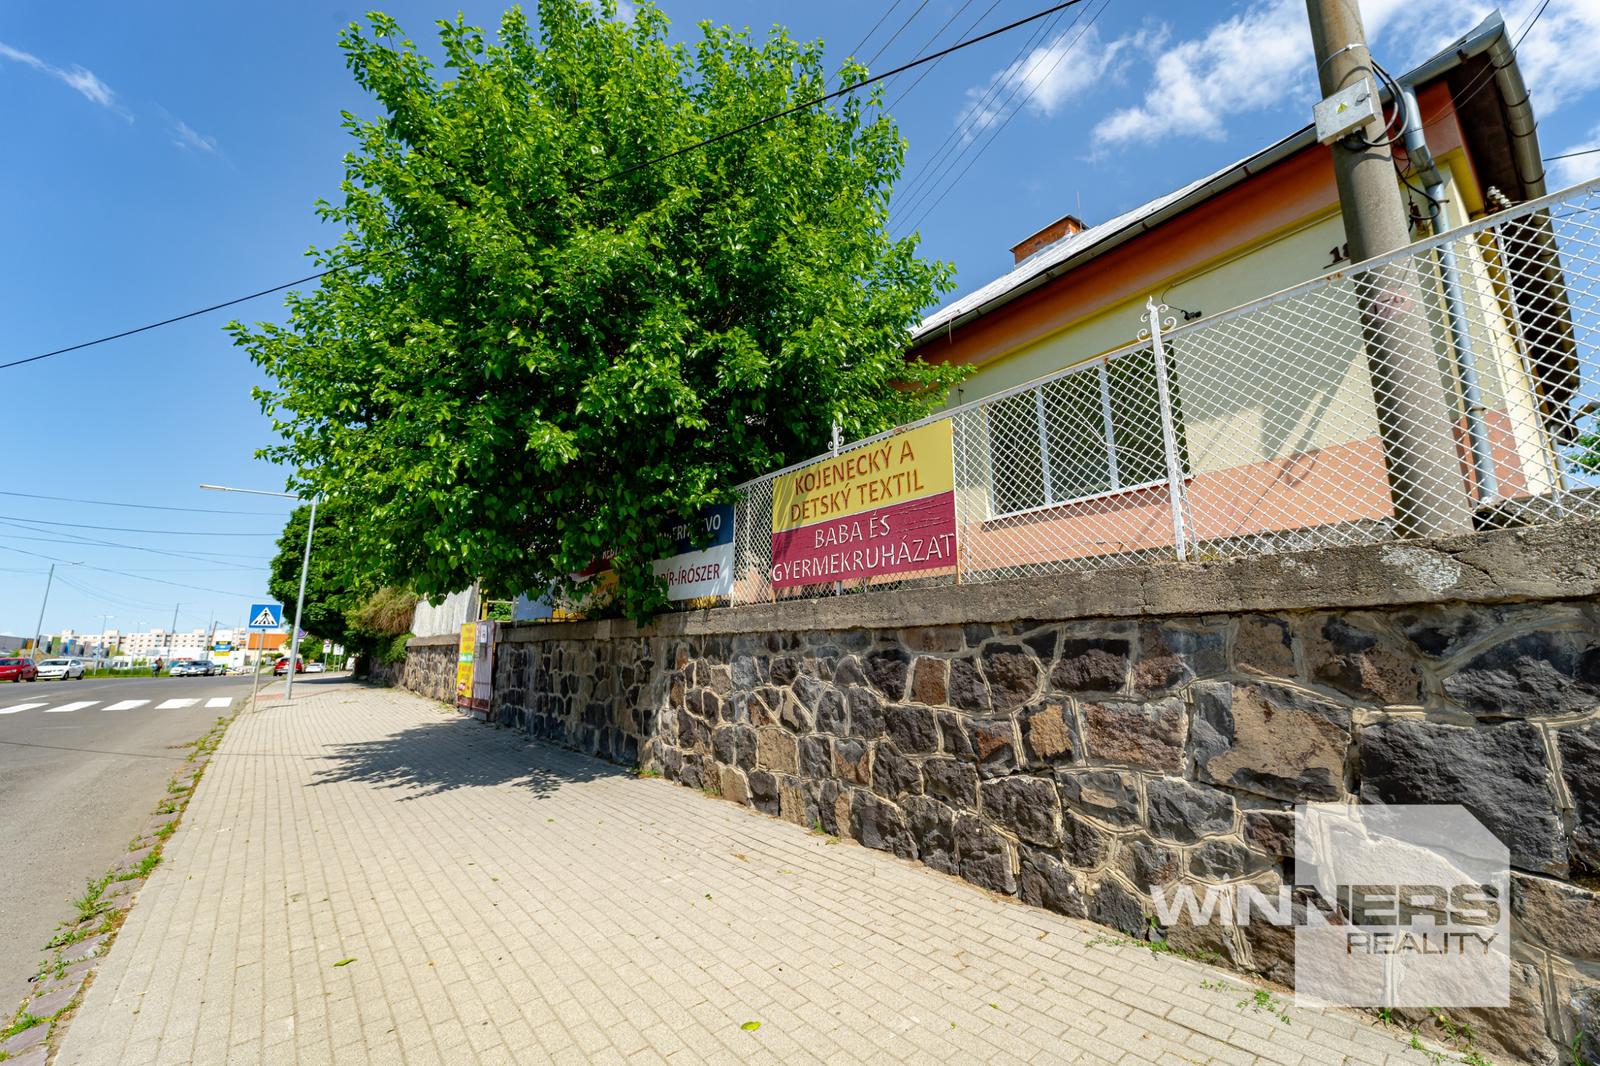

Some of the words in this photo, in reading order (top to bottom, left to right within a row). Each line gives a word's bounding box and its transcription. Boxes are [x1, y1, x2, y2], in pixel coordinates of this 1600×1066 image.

[795, 441, 892, 496] KOJENECKÝ
[899, 439, 915, 465] A
[791, 484, 851, 522] DETSKÝ
[857, 468, 924, 505] TEXTIL
[814, 521, 863, 549] BABA
[869, 509, 891, 539] ÉS
[772, 533, 955, 582] GYERMEKRUHÁZAT
